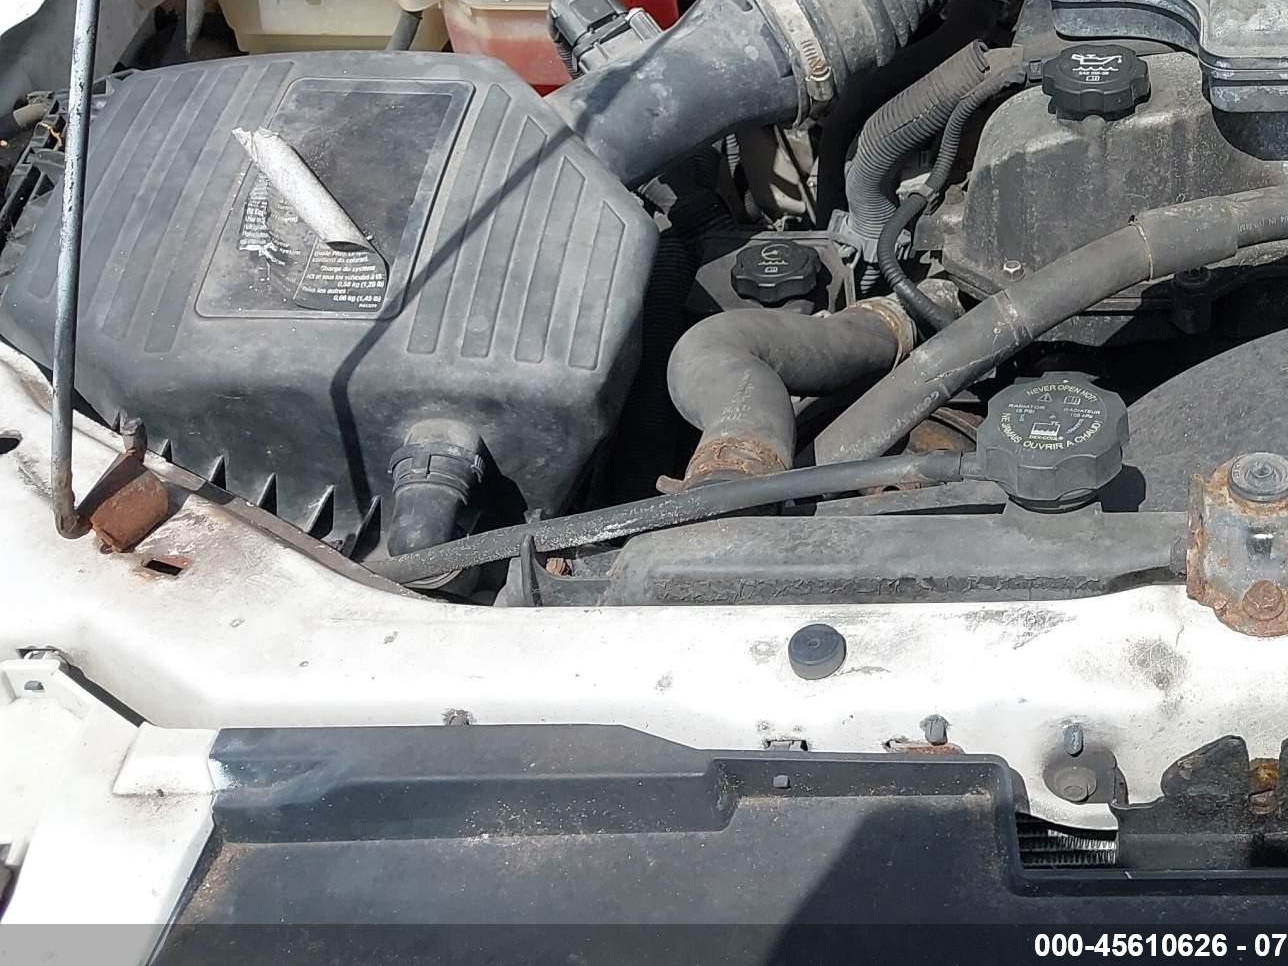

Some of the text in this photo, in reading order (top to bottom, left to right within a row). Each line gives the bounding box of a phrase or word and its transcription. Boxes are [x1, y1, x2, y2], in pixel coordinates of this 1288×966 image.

[320, 265, 342, 273] Charge
[347, 295, 357, 303] kg
[1026, 384, 1057, 396] NEVER
[1057, 384, 1082, 394] OPEN
[1063, 407, 1101, 415] RADIATEUR
[1000, 412, 1012, 422] NE
[1001, 422, 1023, 444] JAMAIS
[1023, 440, 1064, 451] OUVRIR
